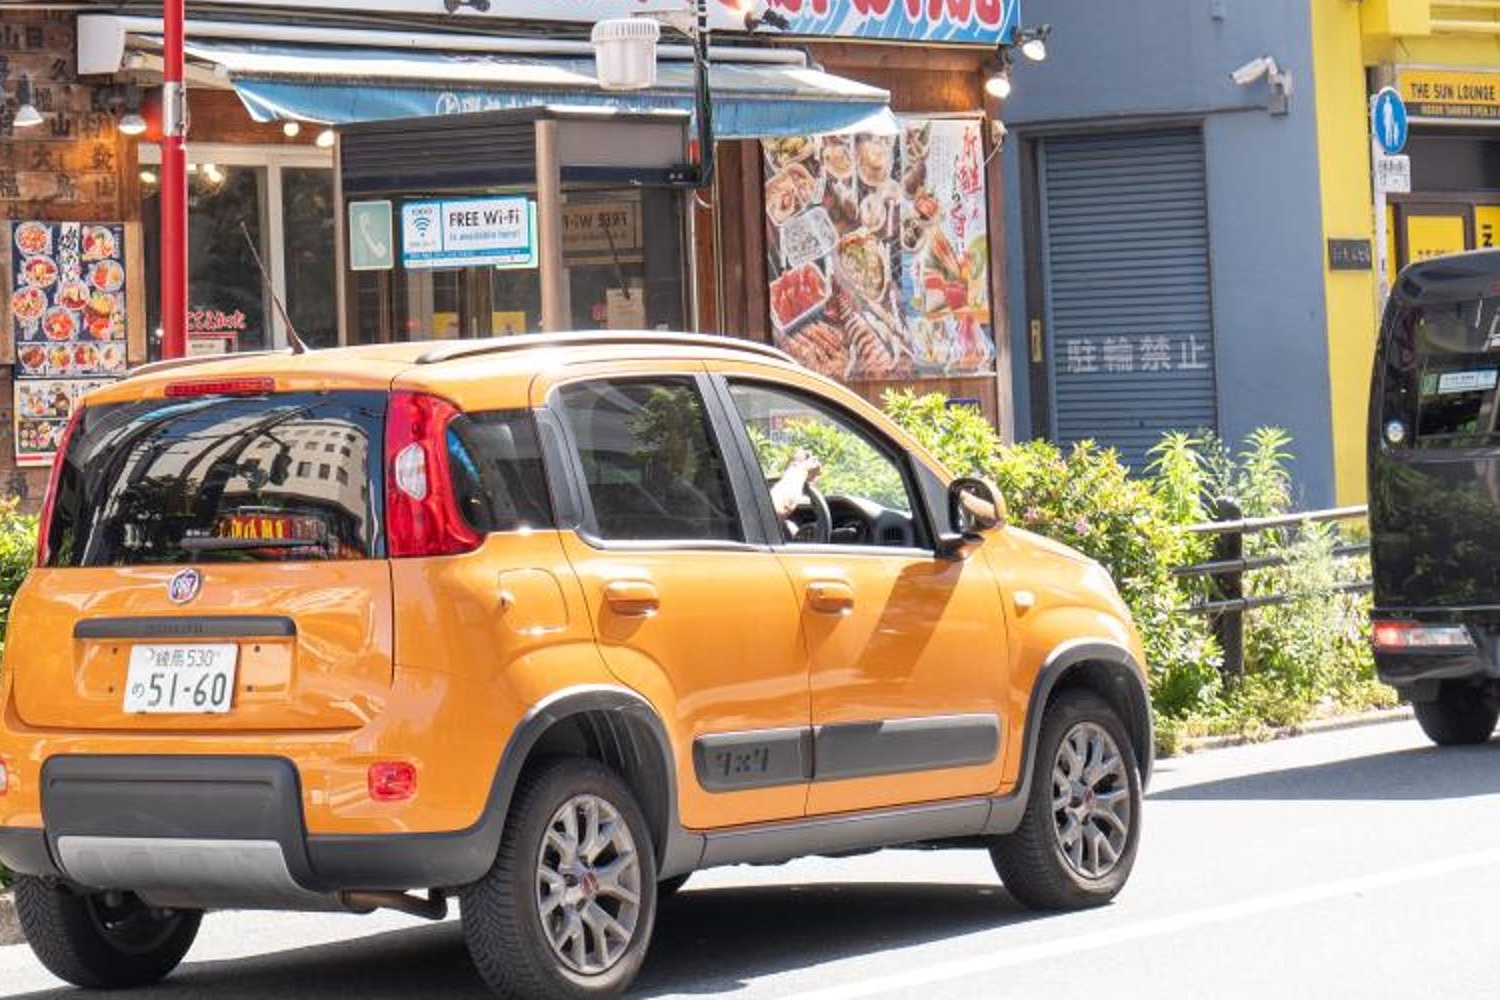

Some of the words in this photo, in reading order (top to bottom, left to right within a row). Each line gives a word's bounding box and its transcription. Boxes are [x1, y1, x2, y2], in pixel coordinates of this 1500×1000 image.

[1457, 84, 1496, 101] LOUNGE
[449, 211, 480, 228] FREE
[483, 208, 520, 225] Wi-Fi
[1065, 335, 1208, 373] 駐輪禁止
[187, 649, 214, 668] 530
[147, 671, 227, 708] 51-60
